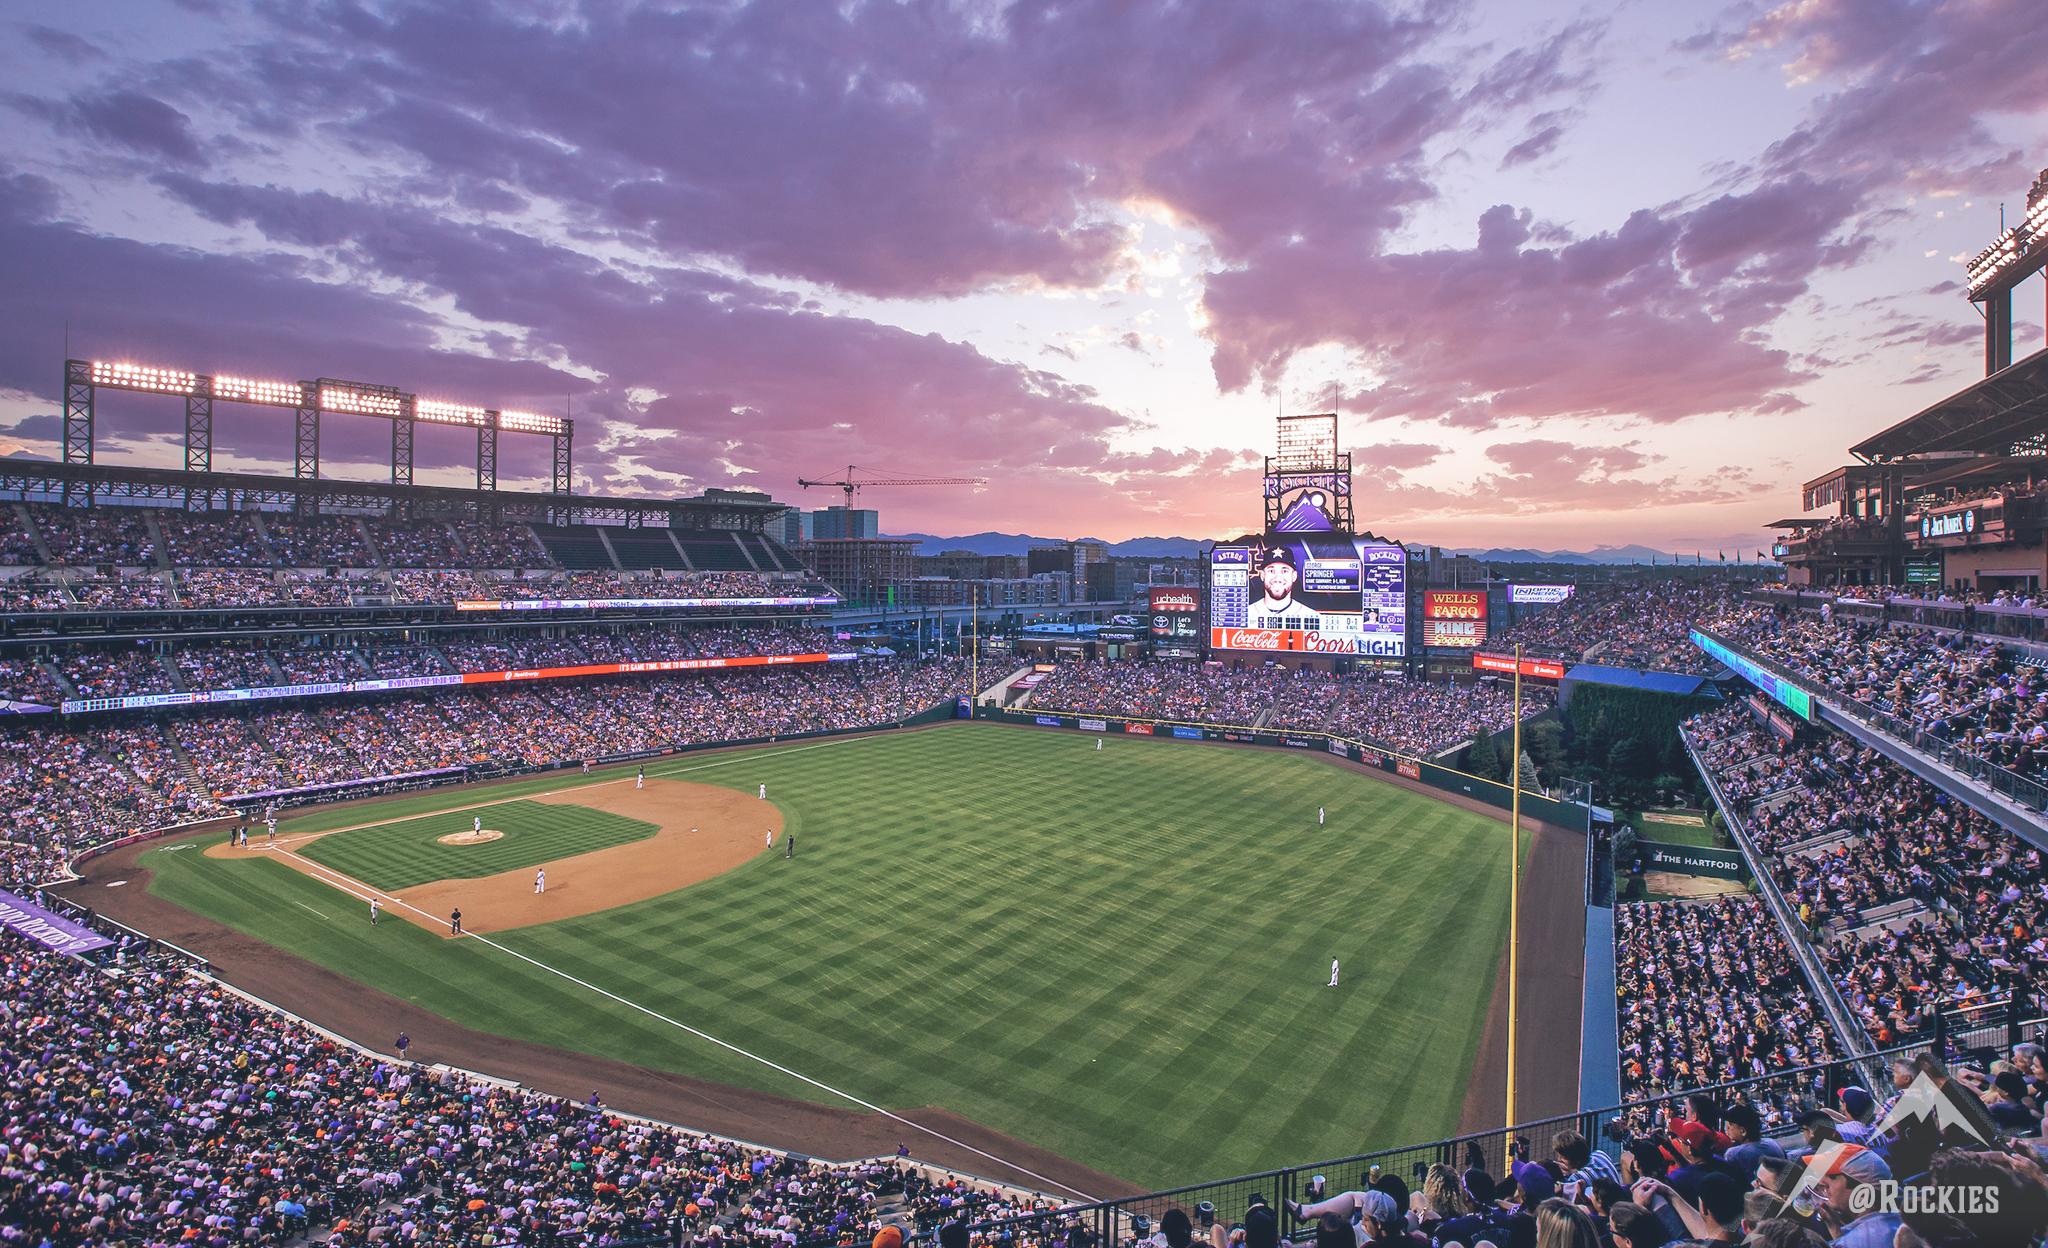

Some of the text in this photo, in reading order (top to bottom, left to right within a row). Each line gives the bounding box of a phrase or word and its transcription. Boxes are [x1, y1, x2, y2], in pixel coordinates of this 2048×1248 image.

[1264, 474, 1351, 496] ROCKIES
[1930, 513, 1963, 537] JACK DANIEL'S
[1217, 551, 1243, 562] ASTROS
[1368, 551, 1401, 562] ROCKIES
[1305, 569, 1335, 579] SPRINGER
[1156, 593, 1193, 604] uchealth
[1432, 594, 1479, 604] WELLS
[1432, 606, 1479, 616] FARGO
[1434, 621, 1476, 635] KING
[1099, 632, 1135, 640] TUNDRA
[1231, 630, 1282, 649] Coca-Cola
[1304, 630, 1404, 656] Coors LIGHT
[619, 664, 629, 672] IT'S
[630, 663, 645, 671] GAME
[646, 662, 659, 670] TIME.
[660, 662, 671, 670] TIME
[680, 661, 699, 669] DELIVER
[699, 660, 708, 668] THE
[709, 659, 727, 667] ENERGY.
[1286, 739, 1308, 747] Fanatics
[1398, 764, 1418, 777] STIHL
[1663, 855, 1739, 870] THE HARTFORD
[12, 917, 78, 946] ROCKIES
